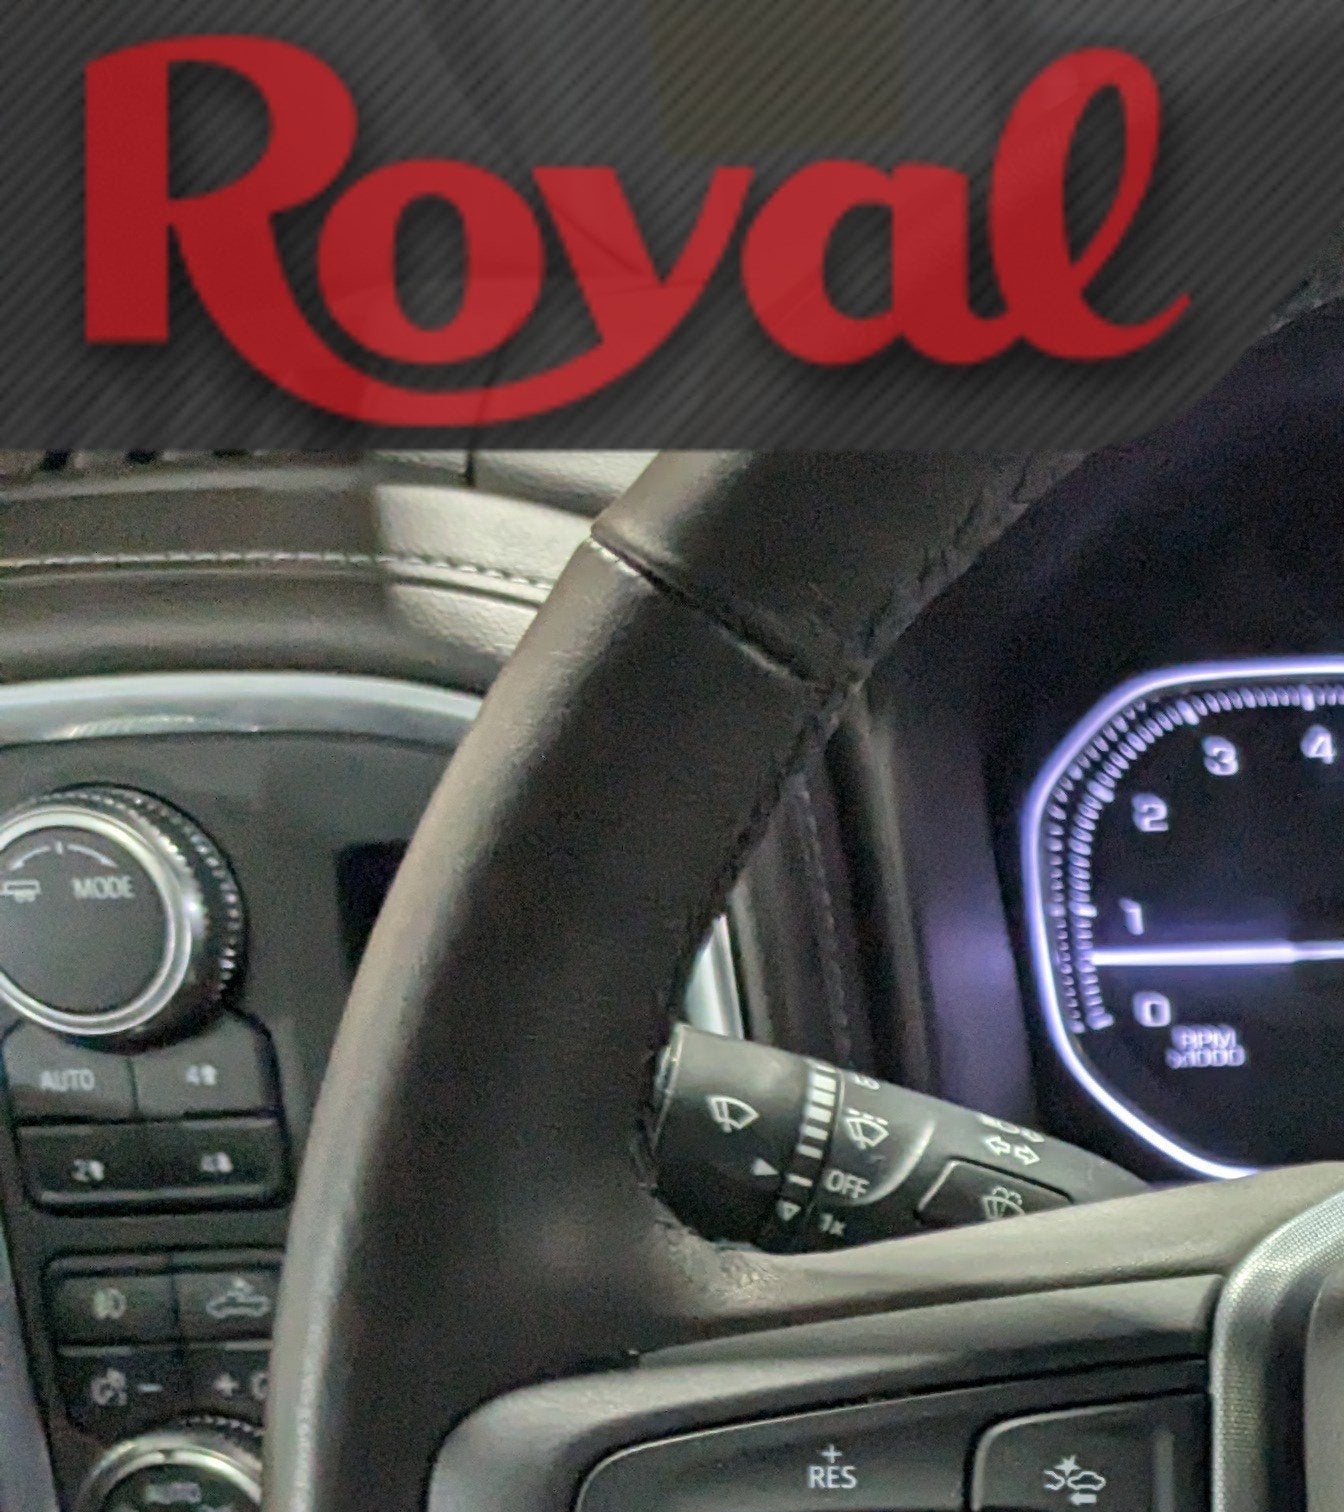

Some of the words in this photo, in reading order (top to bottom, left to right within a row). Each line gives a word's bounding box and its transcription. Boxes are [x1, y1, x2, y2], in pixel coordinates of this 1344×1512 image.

[1202, 735, 1239, 776] 3
[1302, 725, 1336, 765] 4
[1132, 793, 1170, 833] 2
[72, 877, 135, 901] MODE
[1120, 898, 1144, 935] 1
[1132, 990, 1171, 1028] 0
[39, 1069, 95, 1093] AUTO
[825, 1170, 870, 1199] OFF
[808, 1465, 858, 1490] RES
